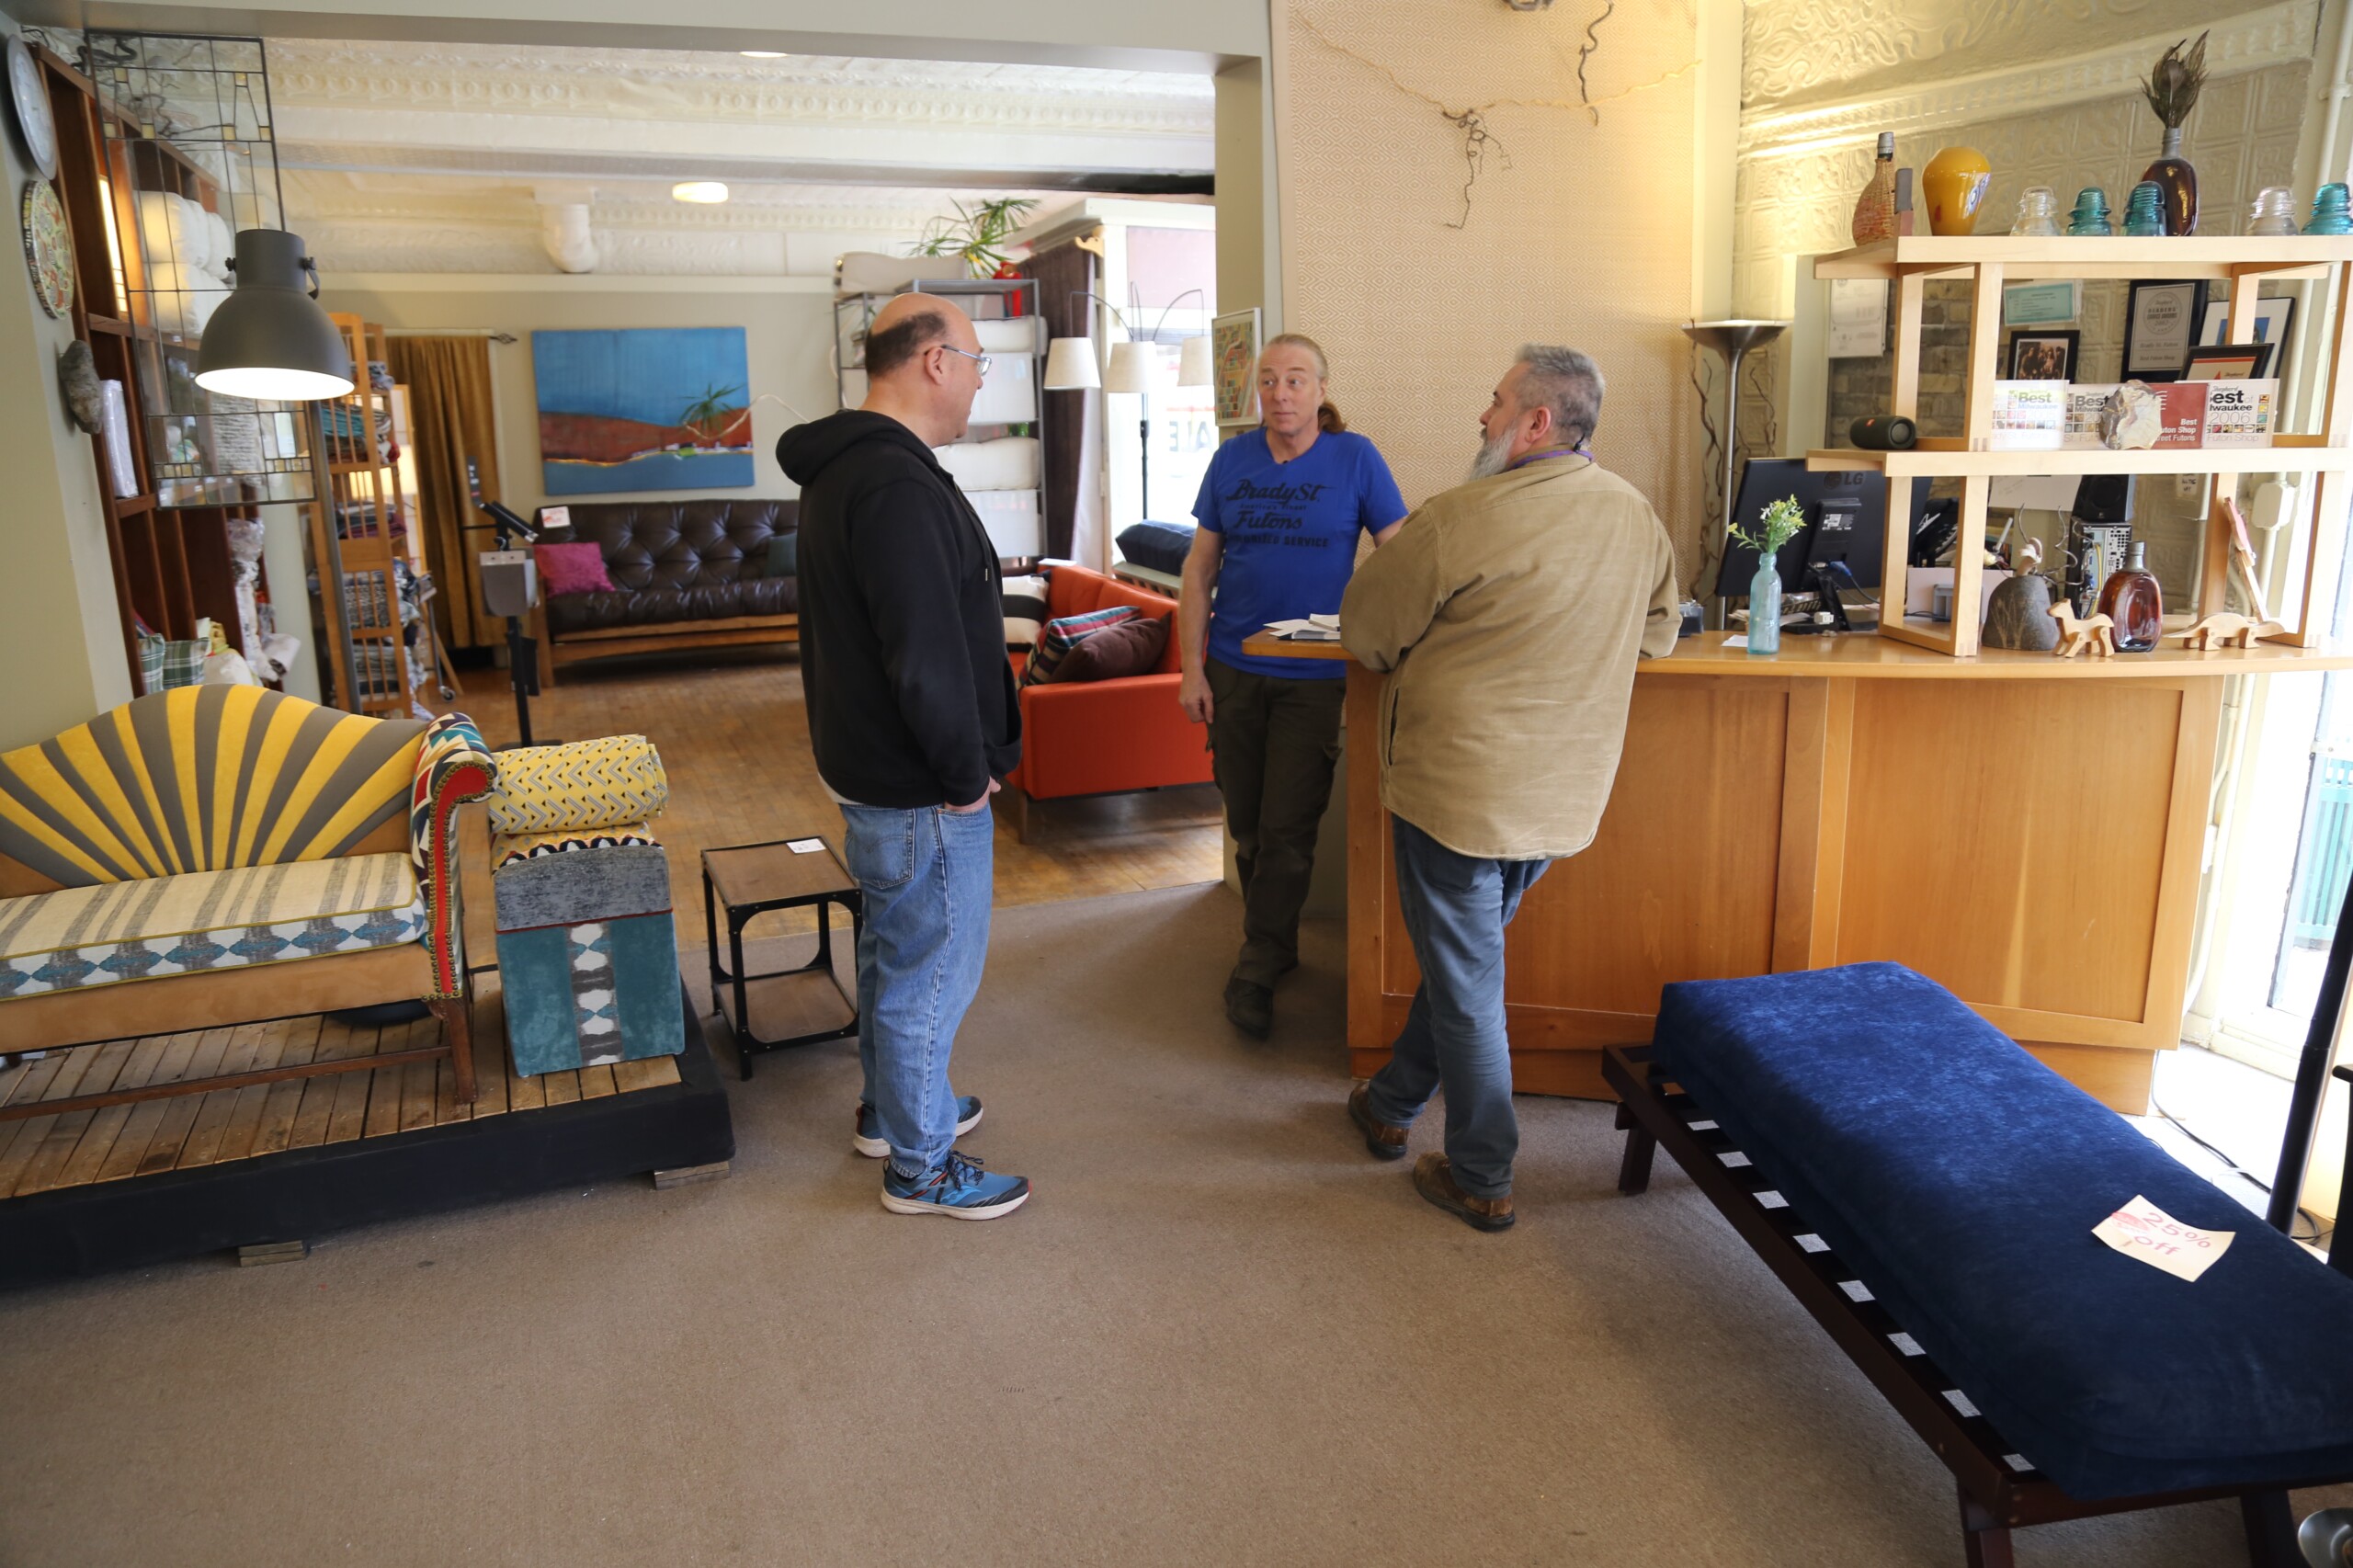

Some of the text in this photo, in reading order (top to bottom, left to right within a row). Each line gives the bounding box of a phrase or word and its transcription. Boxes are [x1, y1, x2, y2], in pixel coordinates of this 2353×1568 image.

[2018, 392, 2052, 403] Best
[2210, 391, 2244, 404] est
[2209, 412, 2251, 425] 2006
[2177, 426, 2197, 435] Shop
[1844, 472, 1864, 485] LG
[1225, 478, 1296, 505] Brady
[1233, 510, 1303, 530] Futons
[1283, 536, 1331, 548] SERVICE
[2142, 1211, 2211, 1249] 25%
